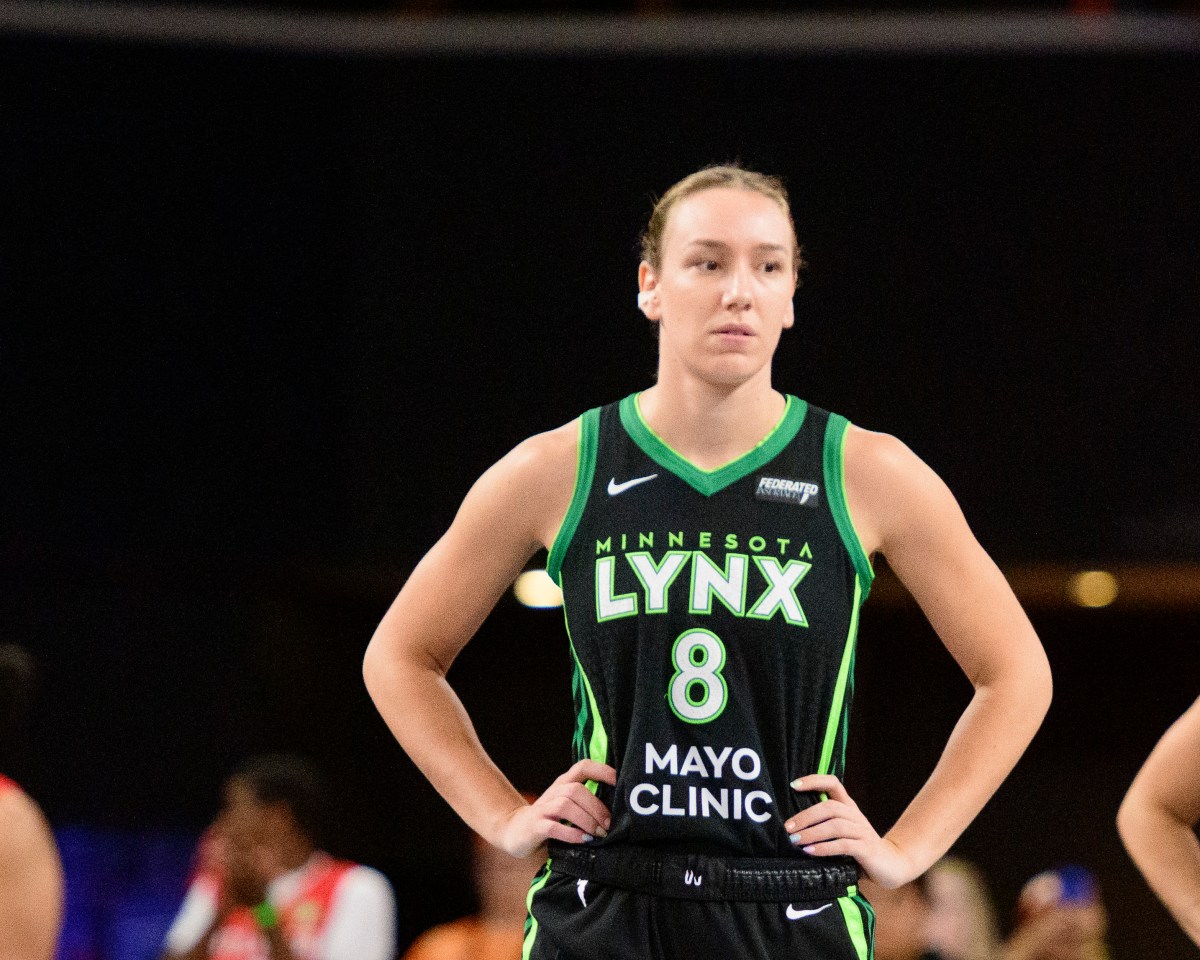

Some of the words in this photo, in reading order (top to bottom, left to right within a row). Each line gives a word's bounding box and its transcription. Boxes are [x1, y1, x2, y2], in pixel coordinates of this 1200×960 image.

[759, 477, 819, 499] FEDERATED
[596, 531, 812, 559] MINNESOTA
[595, 550, 813, 628] LYNX
[667, 627, 728, 725] 8
[645, 742, 761, 781] MAYO
[629, 783, 773, 823] CLINIC
